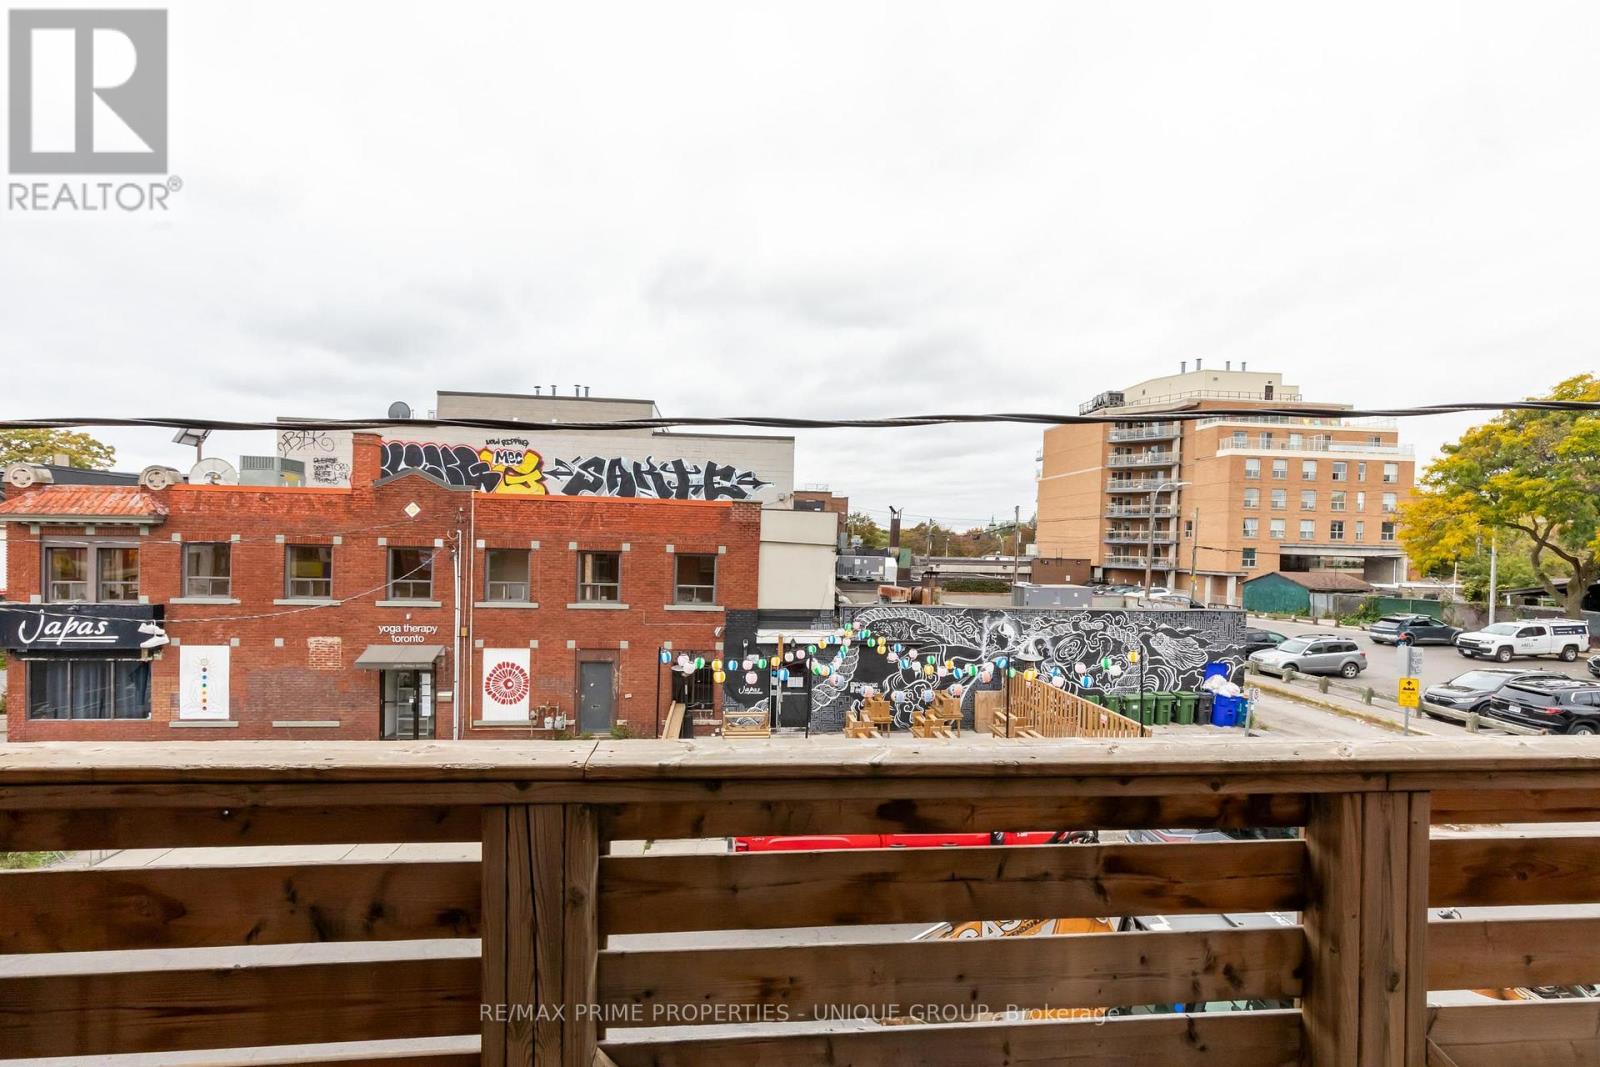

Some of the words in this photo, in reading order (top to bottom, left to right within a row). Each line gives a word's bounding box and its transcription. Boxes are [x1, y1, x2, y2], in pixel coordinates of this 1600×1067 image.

[18, 609, 110, 645] Japas
[378, 625, 401, 634] yoga
[403, 624, 438, 634] therapy
[391, 635, 425, 643] toronto
